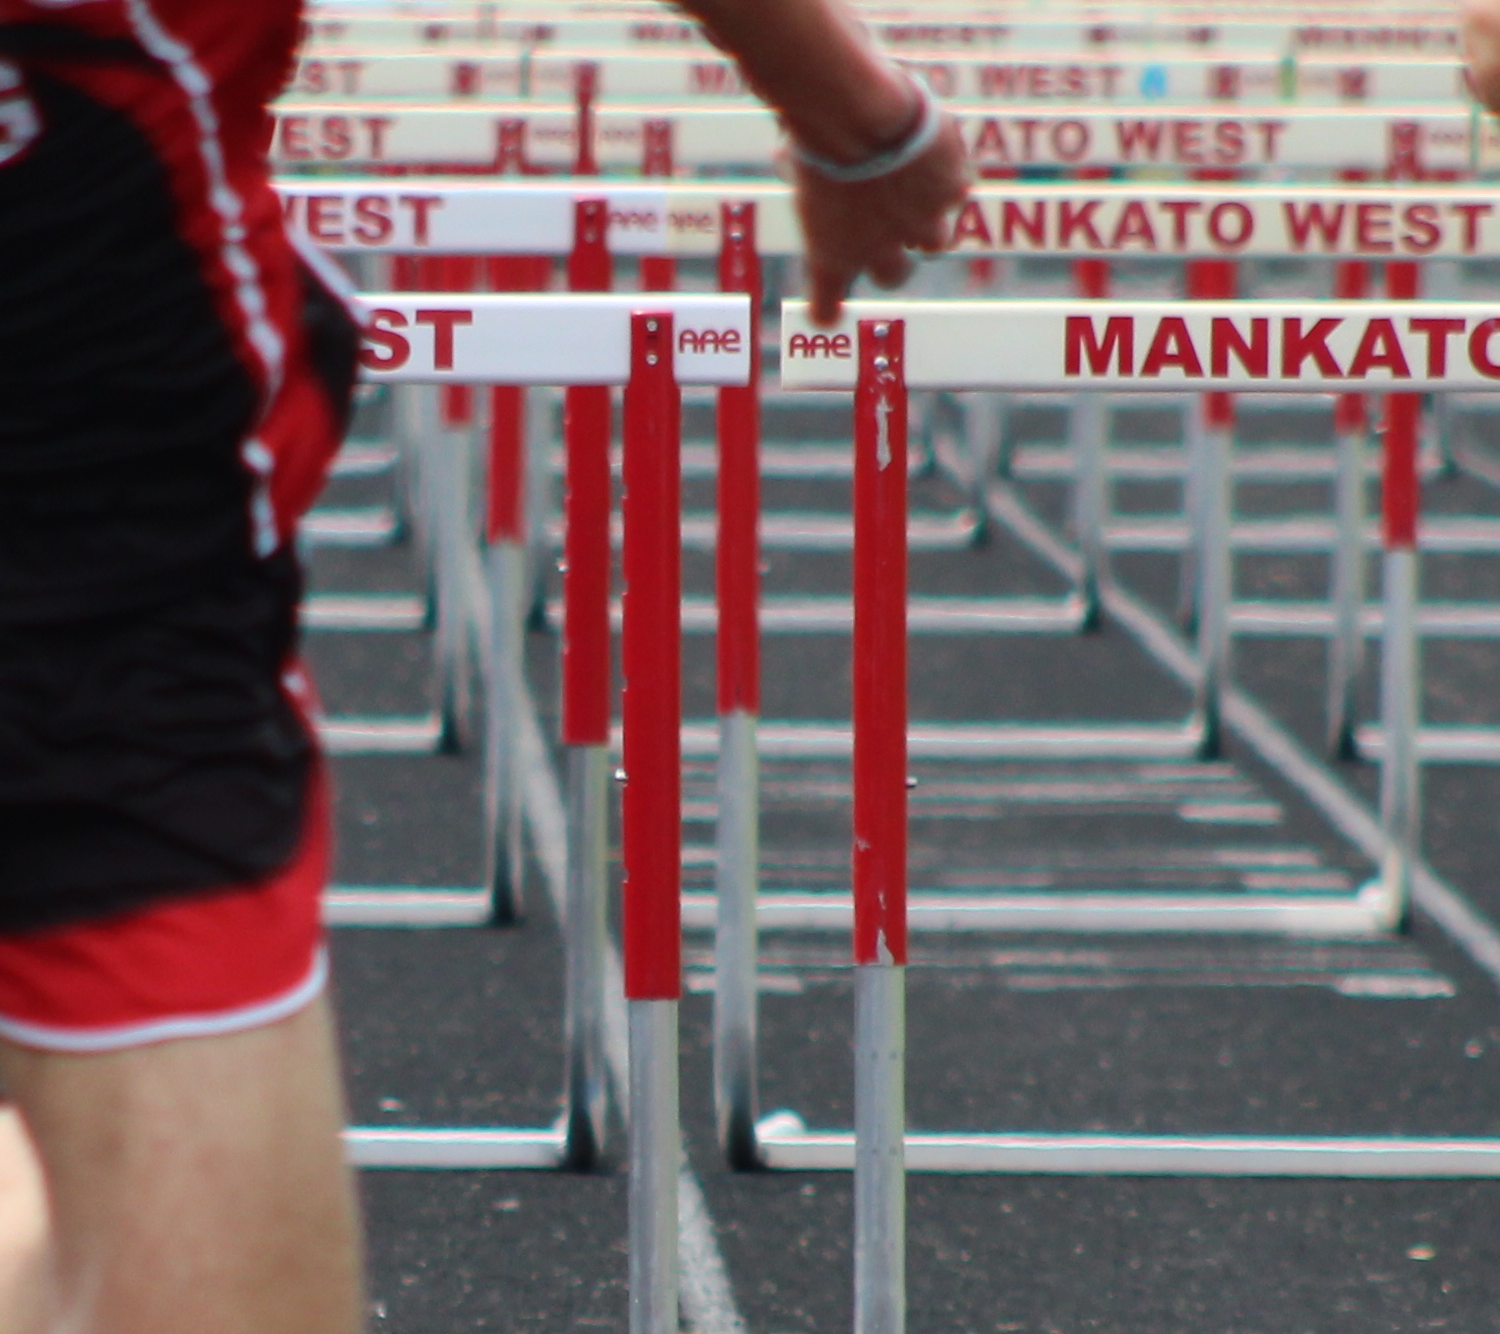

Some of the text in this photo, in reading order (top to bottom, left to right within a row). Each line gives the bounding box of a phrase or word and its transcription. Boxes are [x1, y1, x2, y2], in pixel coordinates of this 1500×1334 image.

[979, 65, 1122, 97] WEST
[280, 116, 393, 160] EST
[1115, 121, 1286, 164] WEST
[284, 195, 444, 249] EST
[952, 199, 1494, 253] ANKATO WEST
[359, 308, 474, 371] ST
